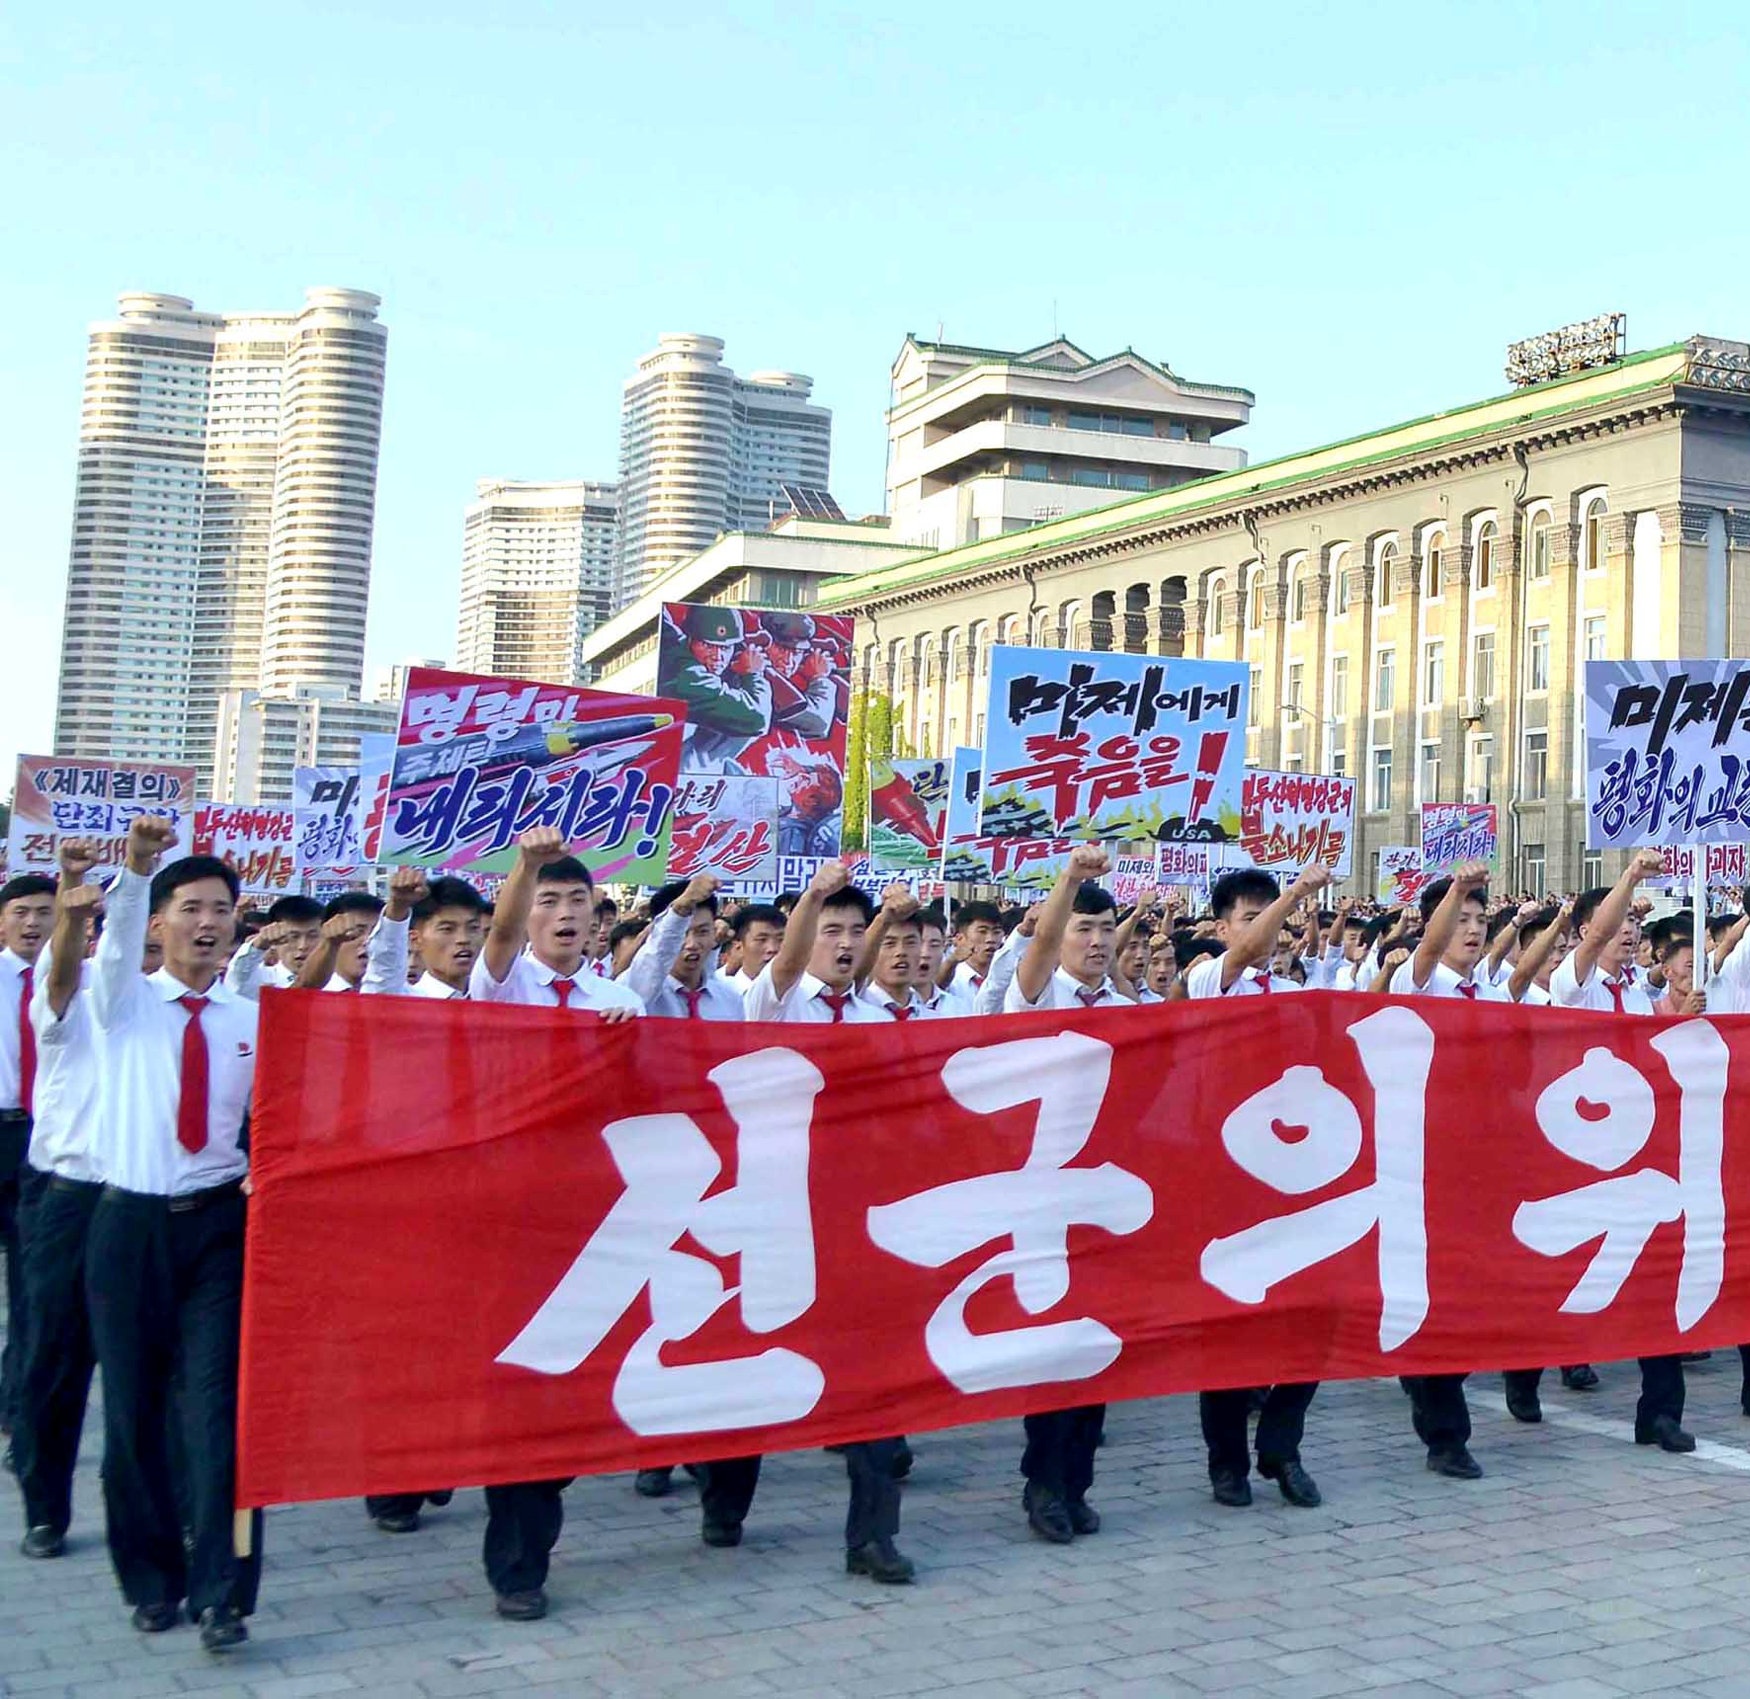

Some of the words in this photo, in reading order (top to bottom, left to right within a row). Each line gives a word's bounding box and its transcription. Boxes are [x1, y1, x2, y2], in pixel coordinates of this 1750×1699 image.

[408, 684, 580, 745] 명령만
[1008, 663, 1240, 739] 미제에게
[35, 767, 182, 801] 《제재결의》
[394, 765, 673, 859] 내리시라!
[988, 731, 1229, 835] 죽음을!
[1171, 829, 1212, 841] USA
[495, 1006, 1433, 1438] 선군의
